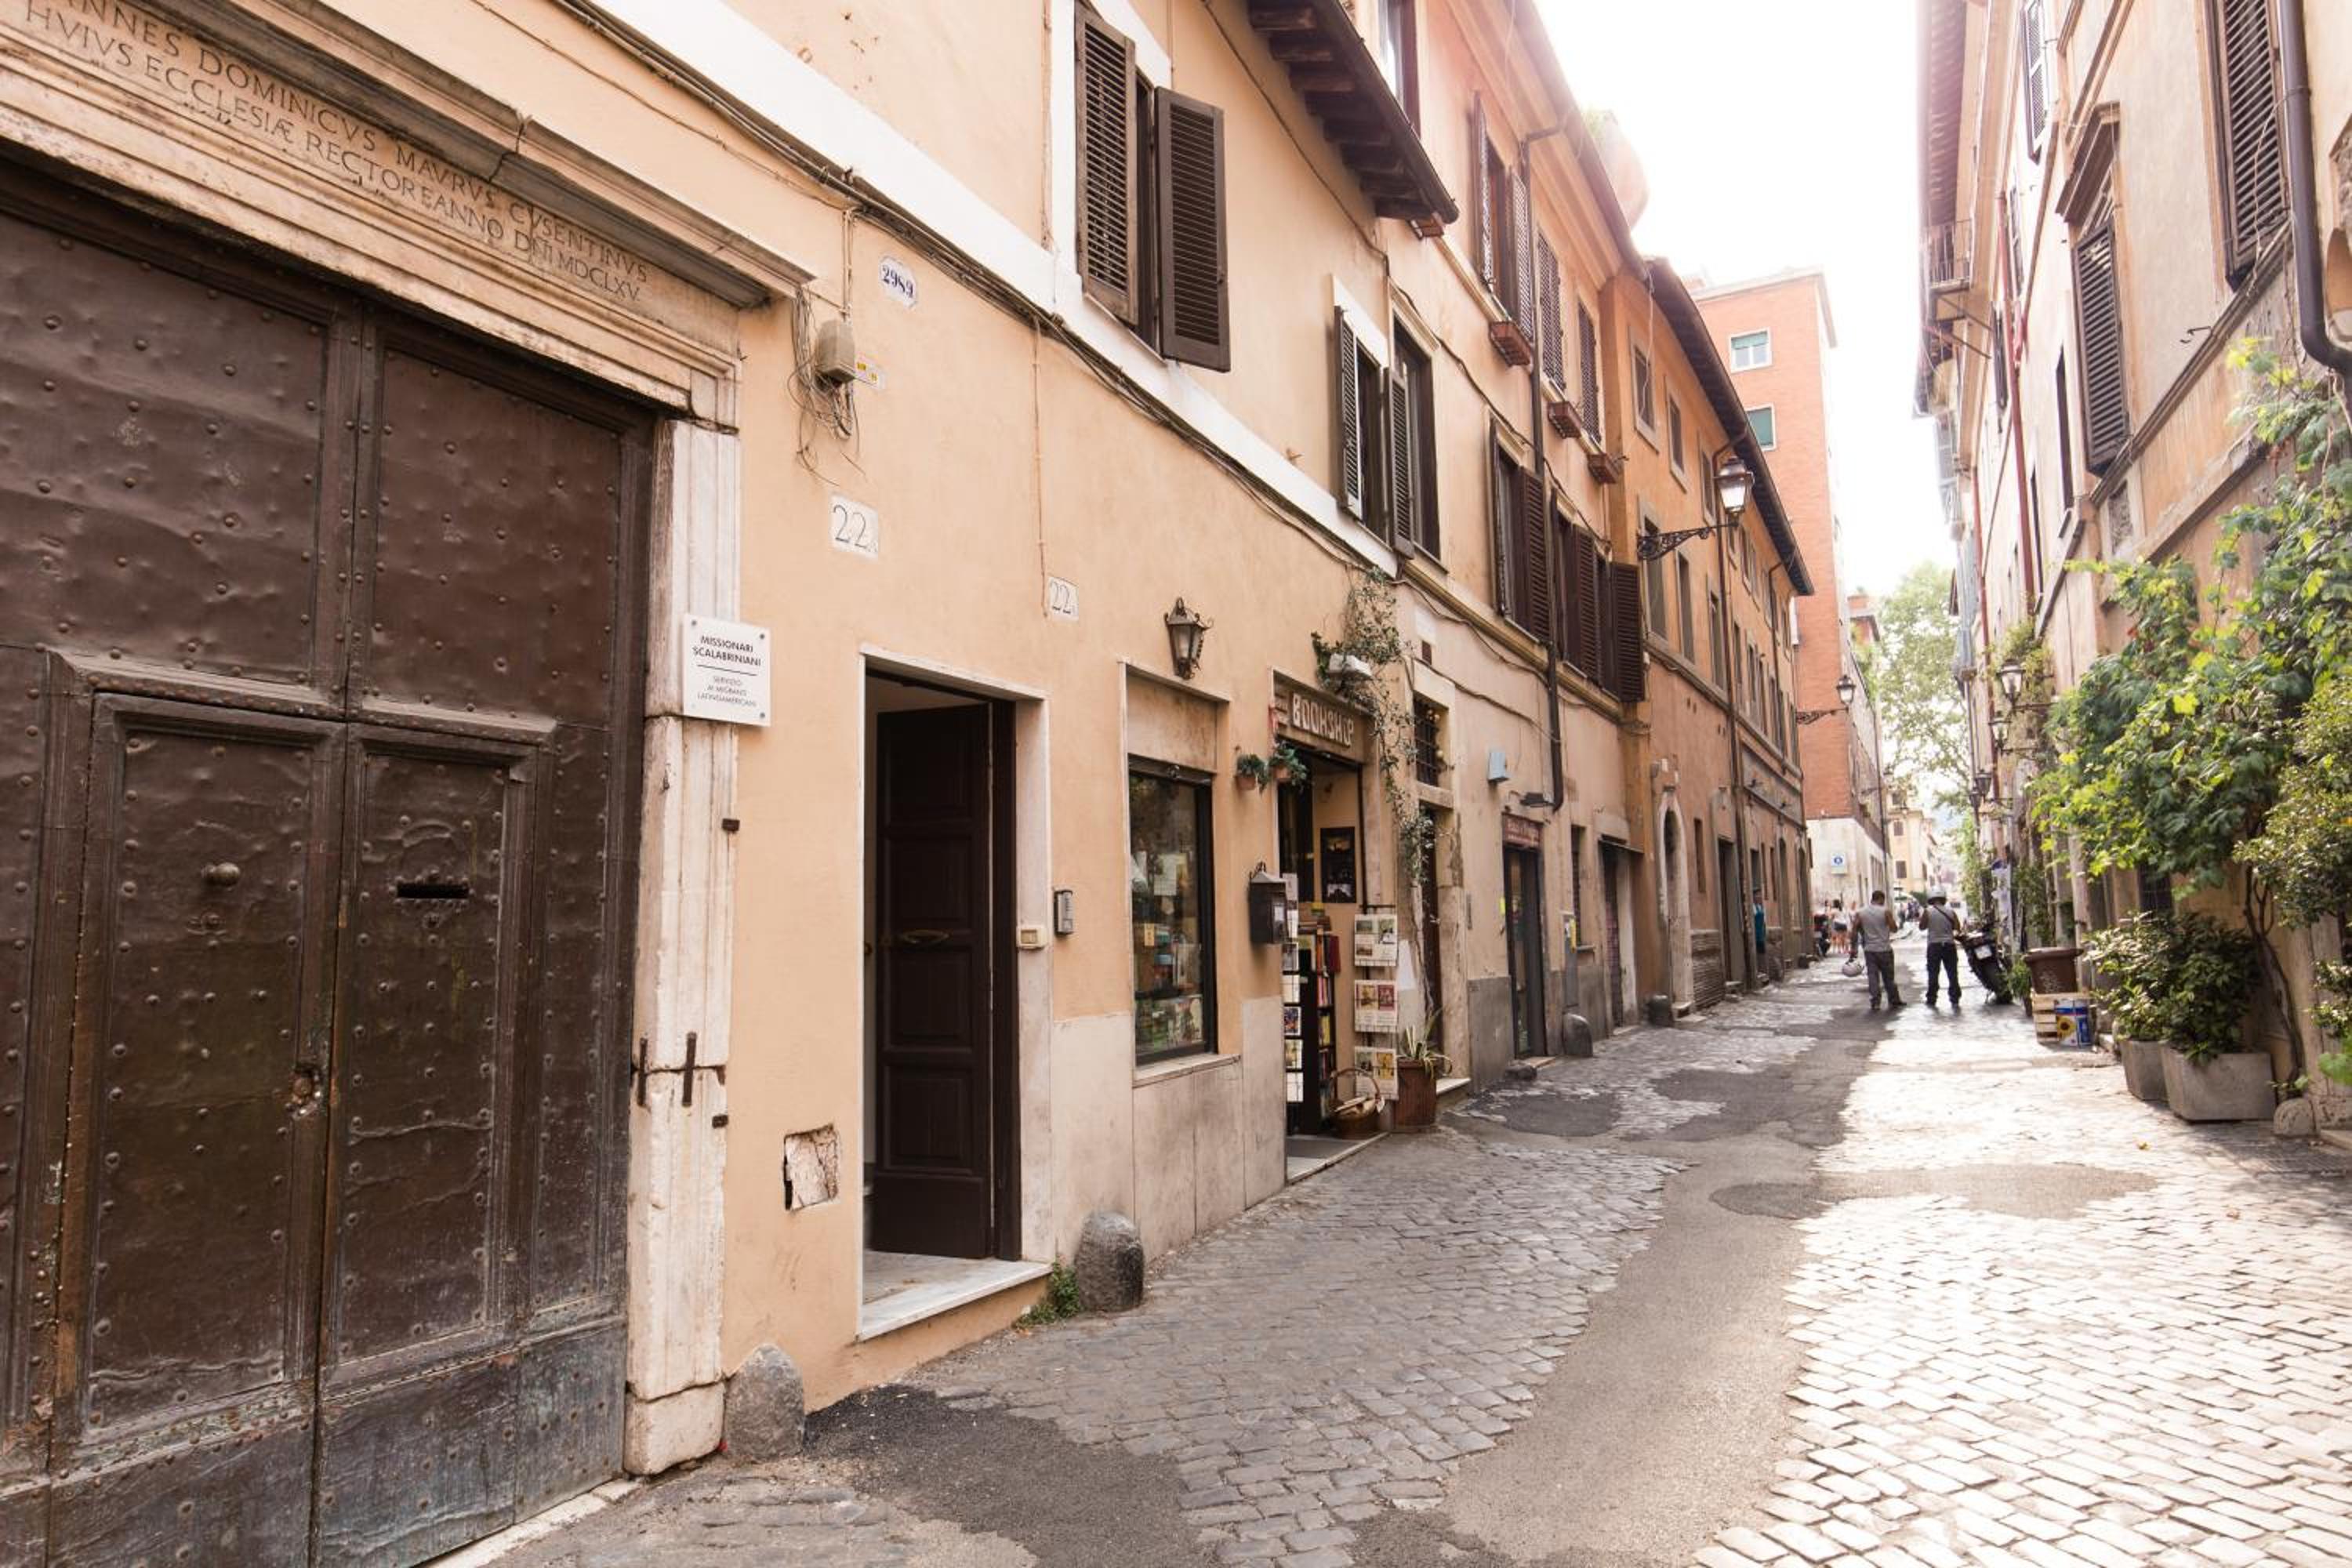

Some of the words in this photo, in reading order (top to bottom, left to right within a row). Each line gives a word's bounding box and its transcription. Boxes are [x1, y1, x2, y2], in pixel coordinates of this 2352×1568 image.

[27, 0, 133, 67] HVIVS
[67, 0, 180, 57] NNES
[198, 48, 377, 151] DOMINICVS
[396, 146, 497, 209] MAVRVS
[691, 646, 761, 666] SCALABRINIANI
[700, 635, 753, 653] MISSIONARI
[1292, 691, 1355, 747] BOOKSHOP
